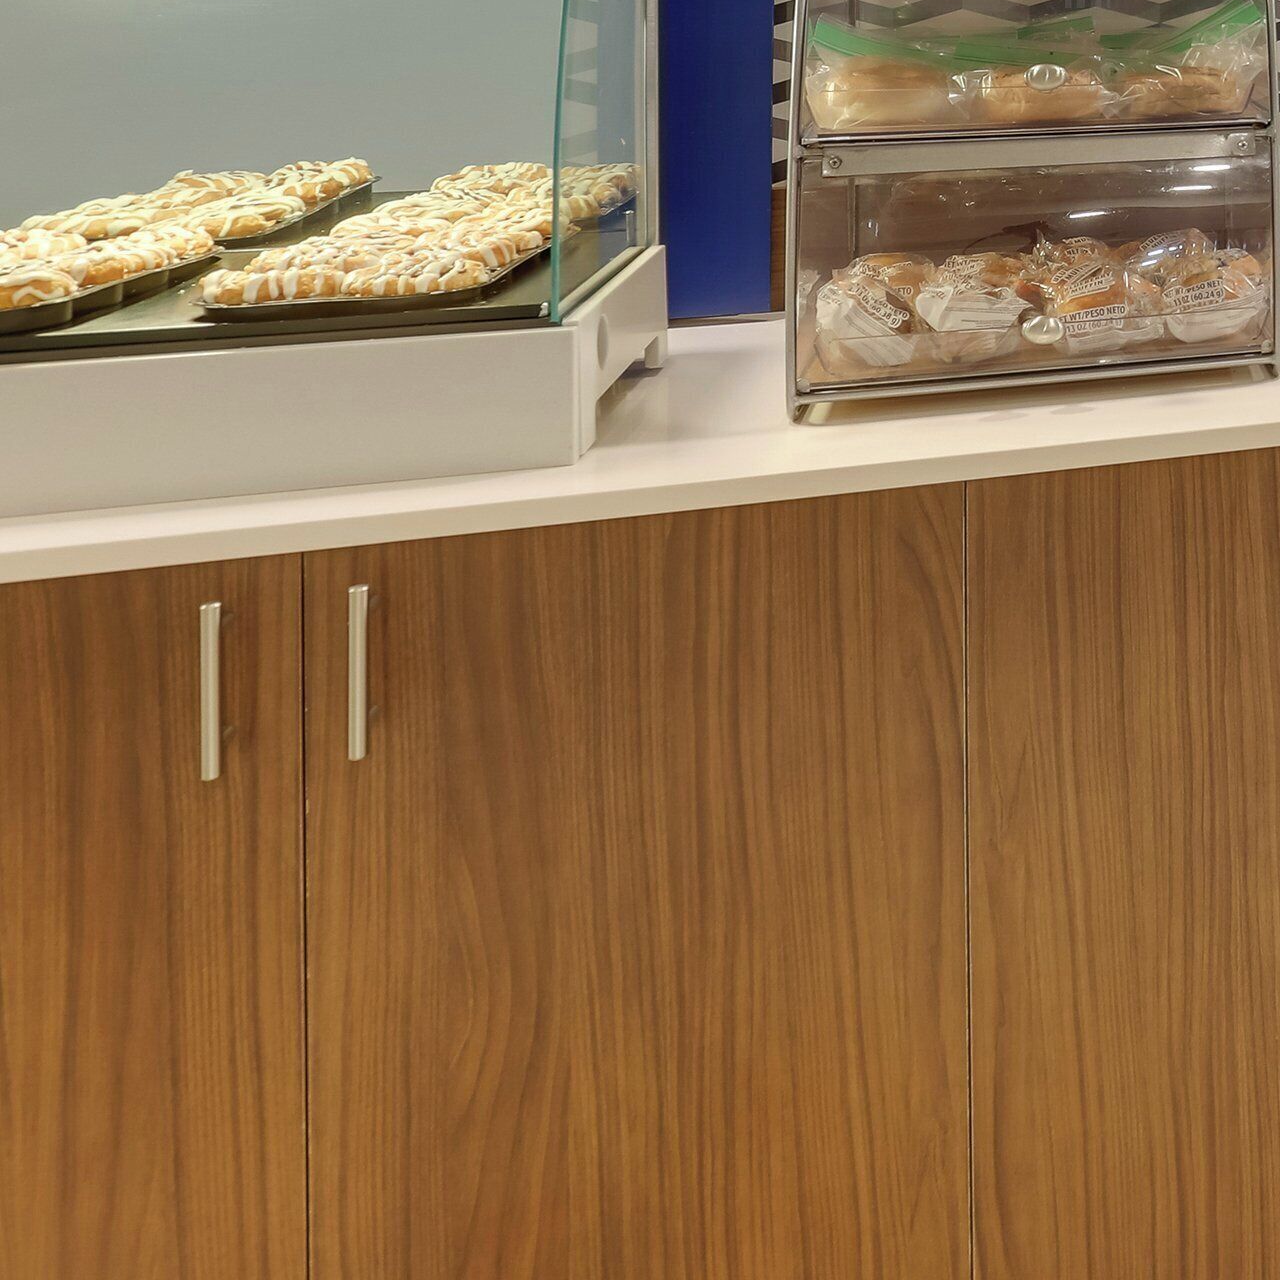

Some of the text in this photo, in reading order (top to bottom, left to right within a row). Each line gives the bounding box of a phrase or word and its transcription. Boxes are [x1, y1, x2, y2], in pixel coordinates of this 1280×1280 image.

[1070, 279, 1104, 295] MUFFIN
[1069, 308, 1105, 321] WT/PESO
[1106, 305, 1126, 315] NETO
